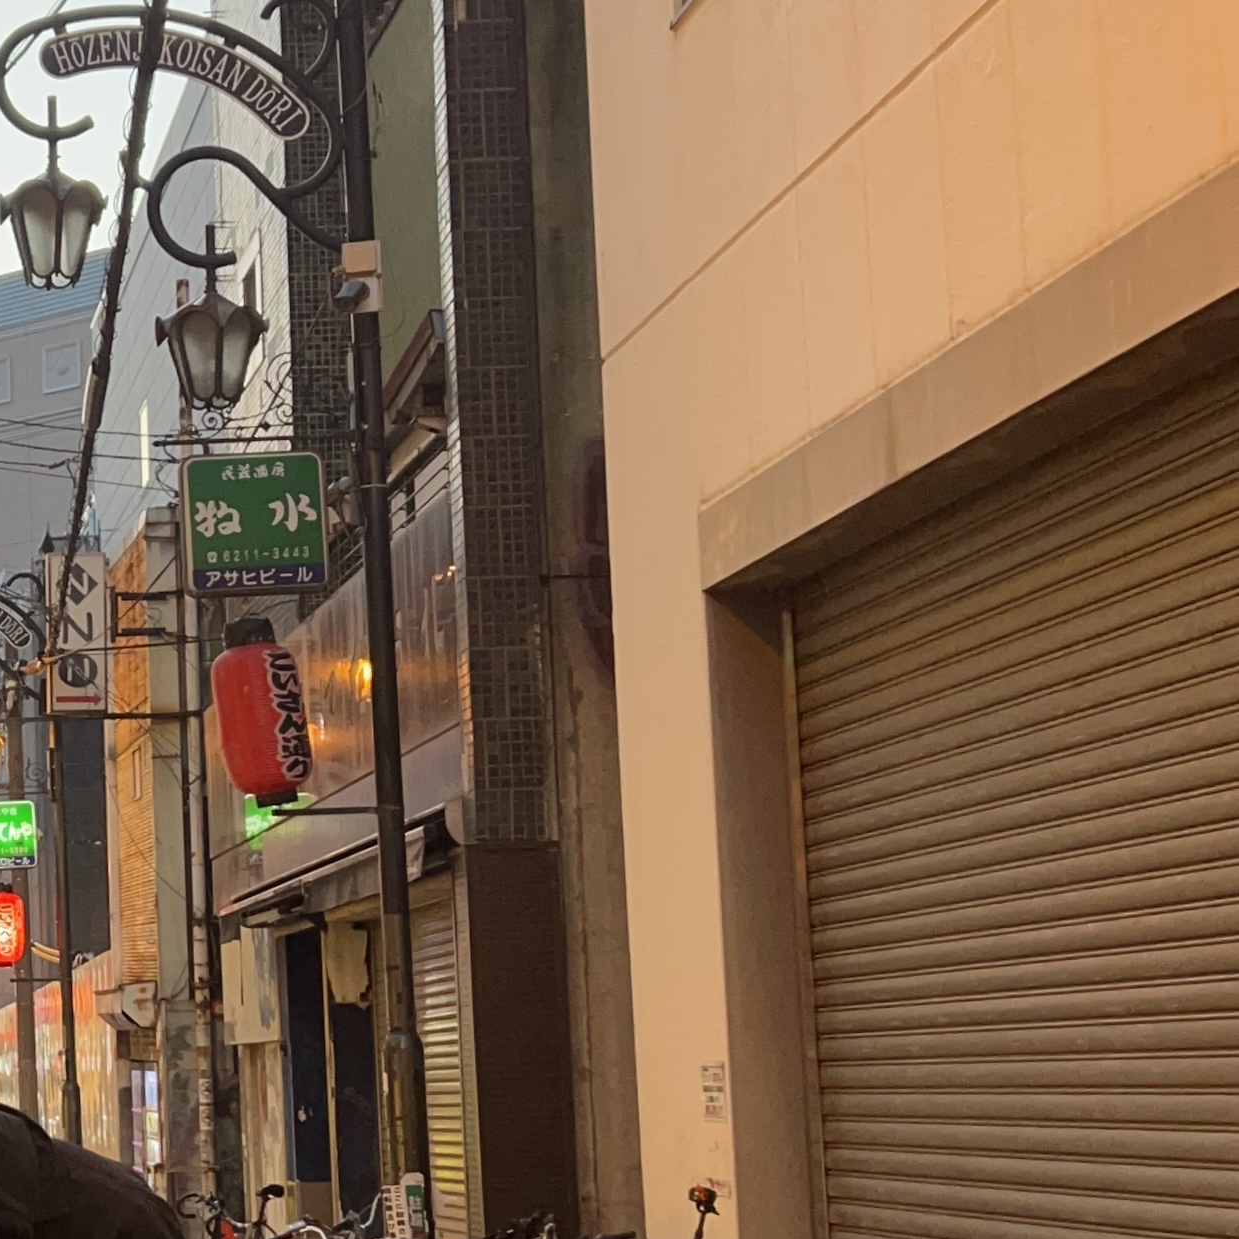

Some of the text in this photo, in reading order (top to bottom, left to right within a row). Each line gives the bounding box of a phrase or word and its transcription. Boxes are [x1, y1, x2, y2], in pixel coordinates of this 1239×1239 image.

[158, 33, 250, 92] KOISAN
[205, 566, 313, 587] アサヒビール
